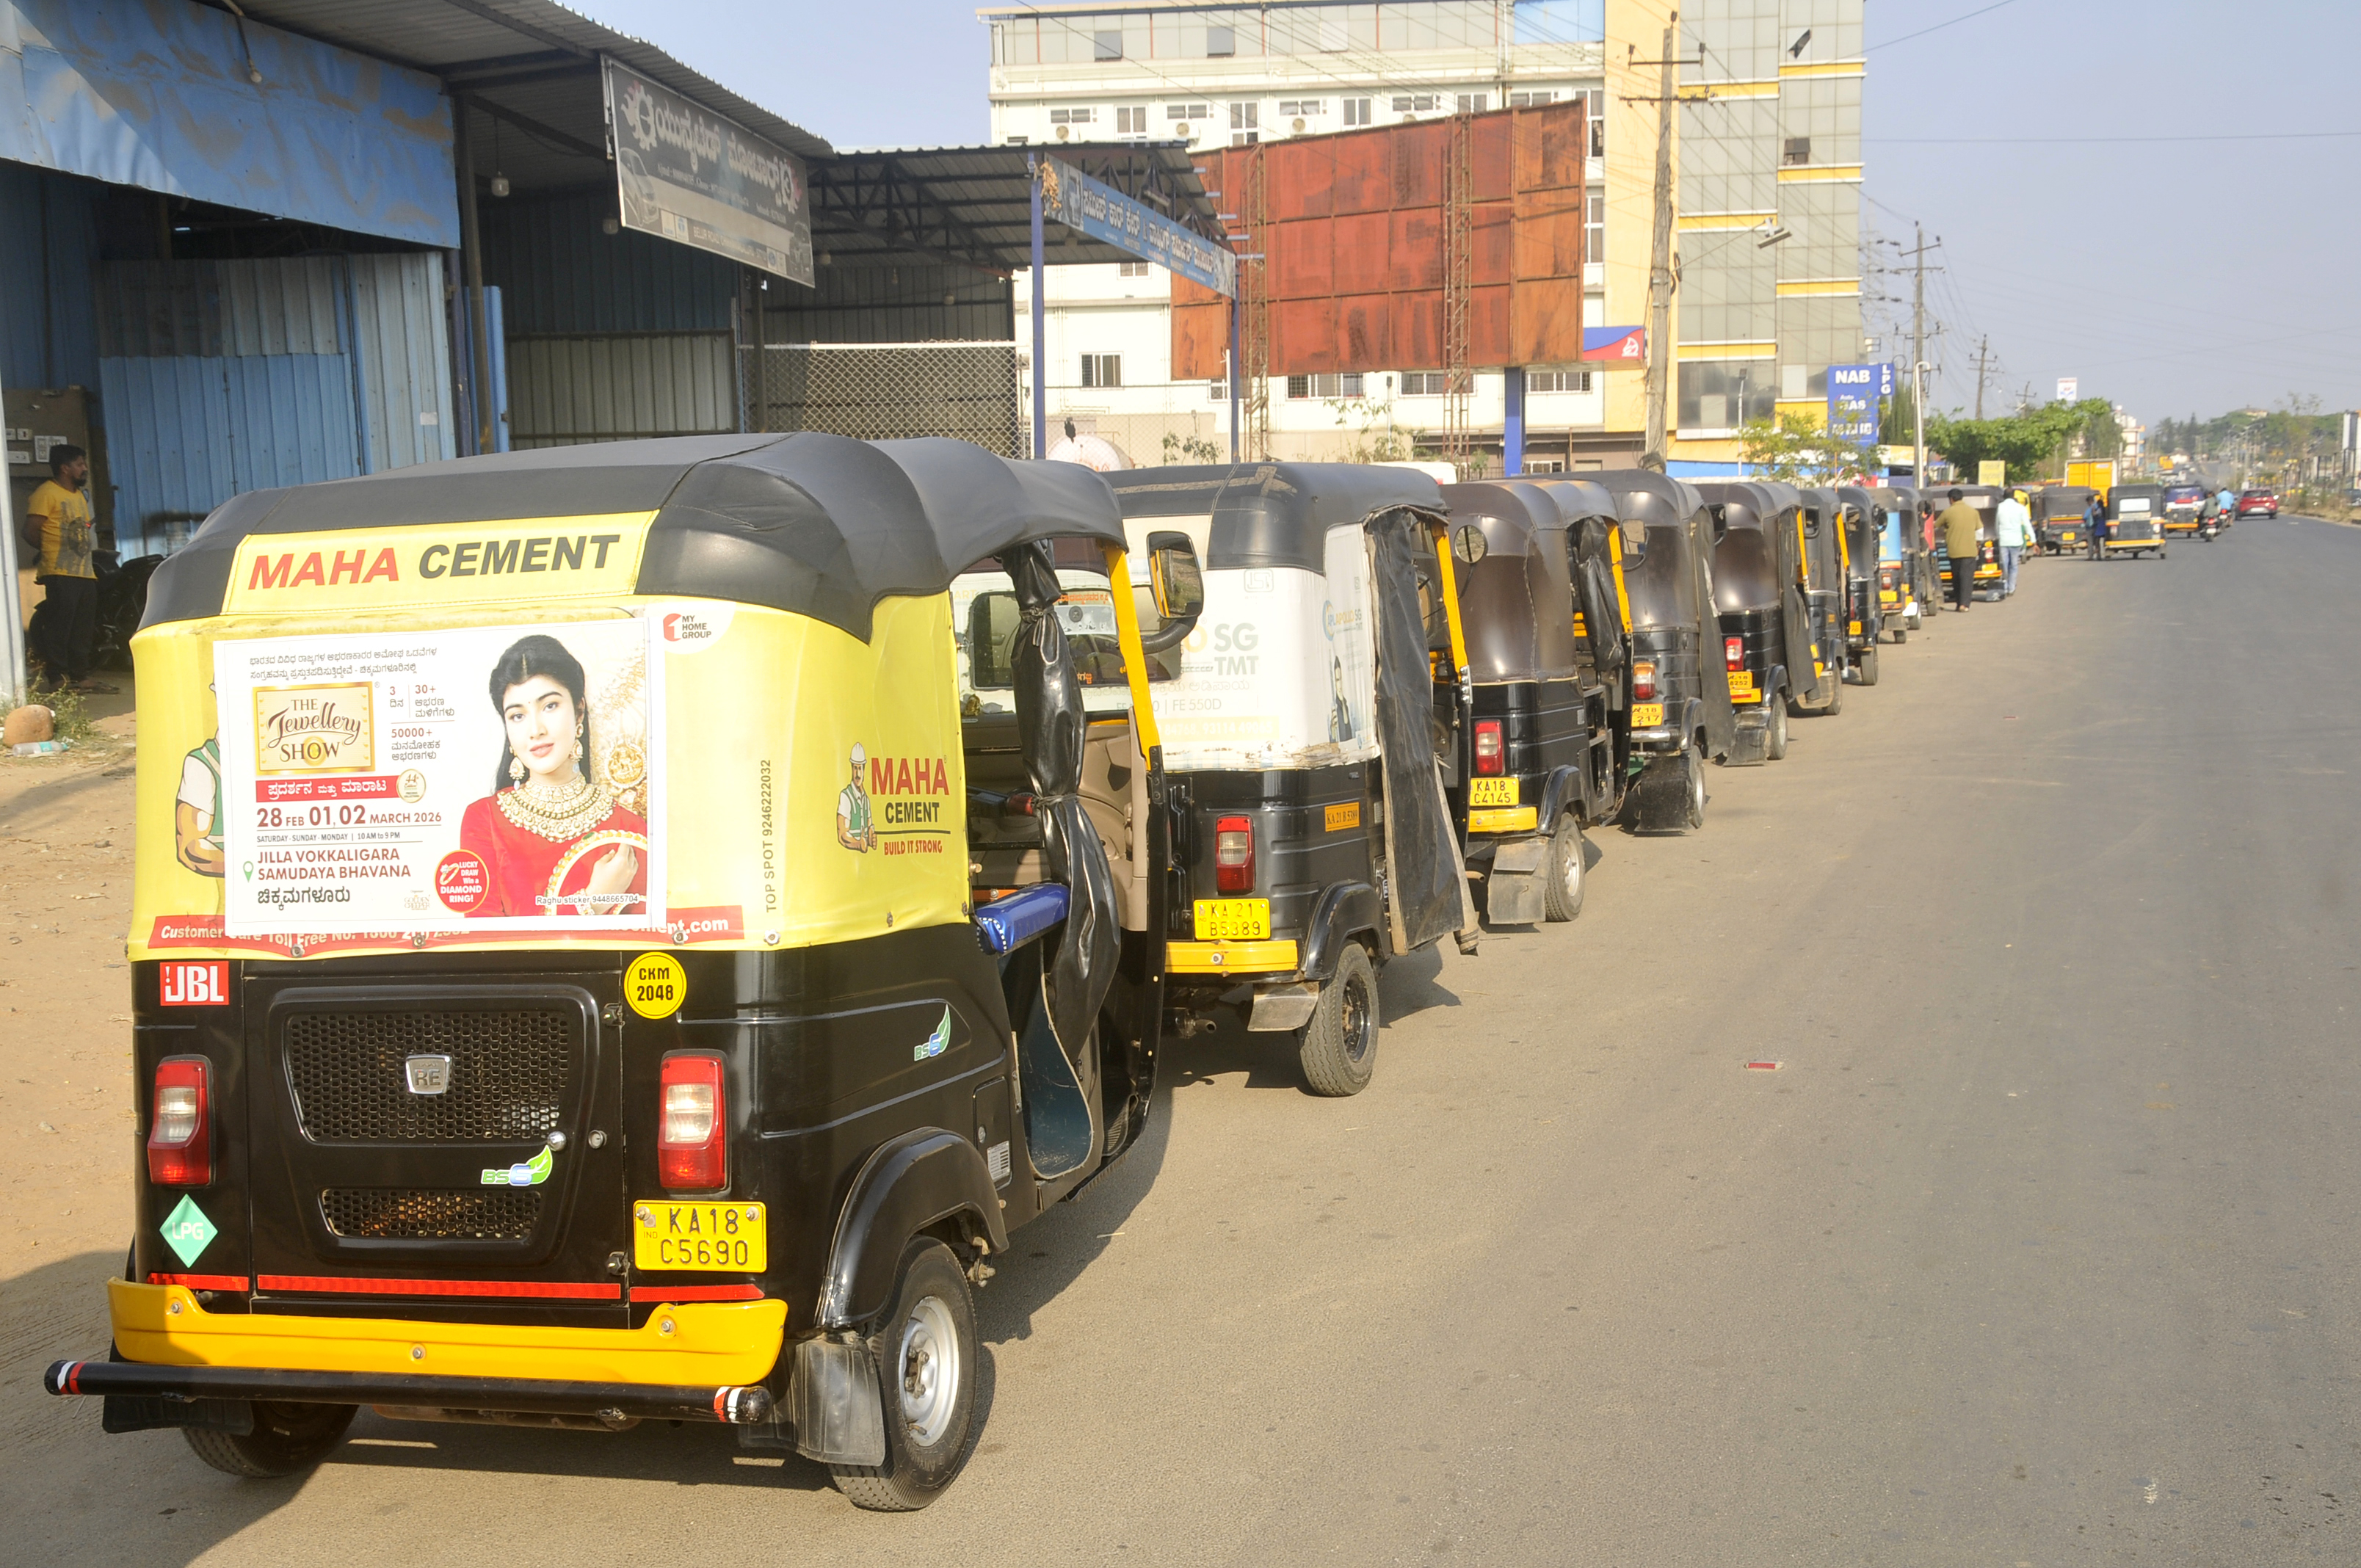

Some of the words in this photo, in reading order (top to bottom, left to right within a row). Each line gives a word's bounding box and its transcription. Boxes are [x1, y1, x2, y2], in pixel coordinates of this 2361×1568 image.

[1835, 369, 1871, 384] NAB
[1880, 364, 1891, 395] LPG
[247, 548, 399, 589] MAHA
[418, 534, 620, 579] CEMENT
[1354, 609, 1362, 621] SG
[682, 631, 712, 639] GROUP
[1214, 623, 1259, 652] SG
[1214, 656, 1259, 676] TMT
[390, 686, 396, 695] 3
[291, 698, 318, 711] THE
[390, 698, 404, 708] ದಿನ
[1172, 700, 1186, 711] FE
[1189, 698, 1222, 711] 550D
[267, 702, 360, 749] Jewellery
[280, 741, 340, 763] SHOW
[391, 740, 440, 750] ಮನಮೋಹಕ
[391, 751, 437, 762] ಆಭರಣಗಳು
[871, 758, 950, 796] MAHA
[267, 781, 313, 799] ಪ್ರದರ್ಶನ
[317, 785, 338, 797] ಮತ್ತು
[341, 779, 388, 794] ಮಾರಾಟ
[761, 759, 772, 836] 9246222032
[1473, 793, 1511, 804] C4145
[257, 807, 283, 827] 28
[286, 816, 305, 827] FEB
[339, 805, 366, 825] 02
[369, 813, 411, 824] MARCH
[413, 812, 442, 823] 2026
[885, 802, 940, 824] CEMENT
[366, 832, 377, 840] AM
[258, 851, 292, 863] JILLA
[295, 848, 400, 863] VOKKALIGARA
[884, 841, 906, 856] BUILD
[907, 841, 914, 854] IT
[915, 840, 943, 854] STRONG
[764, 841, 775, 879] SPOT
[258, 867, 336, 880] SAMUDAYA
[339, 865, 411, 879] BHAVANA
[440, 885, 482, 894] DIAMOND
[258, 886, 350, 911] ಚಿಕ್ಕಮಗಳೂರು
[449, 894, 474, 903] RING!
[536, 896, 562, 905] Raghu
[564, 896, 590, 904] sticker
[592, 894, 638, 904] 9448665704
[765, 884, 777, 912] TOP
[161, 925, 223, 939] Customer
[269, 934, 292, 948] Toll
[297, 934, 327, 947] Free
[1210, 921, 1261, 936] B5389
[639, 968, 670, 980] CKM
[637, 985, 674, 1001] 2048
[915, 1033, 940, 1060] BS6
[414, 1069, 440, 1086] RE
[482, 1164, 534, 1185] BS6
[172, 1222, 204, 1241] LPG
[643, 1231, 658, 1239] IND
[661, 1239, 749, 1266] C5690
